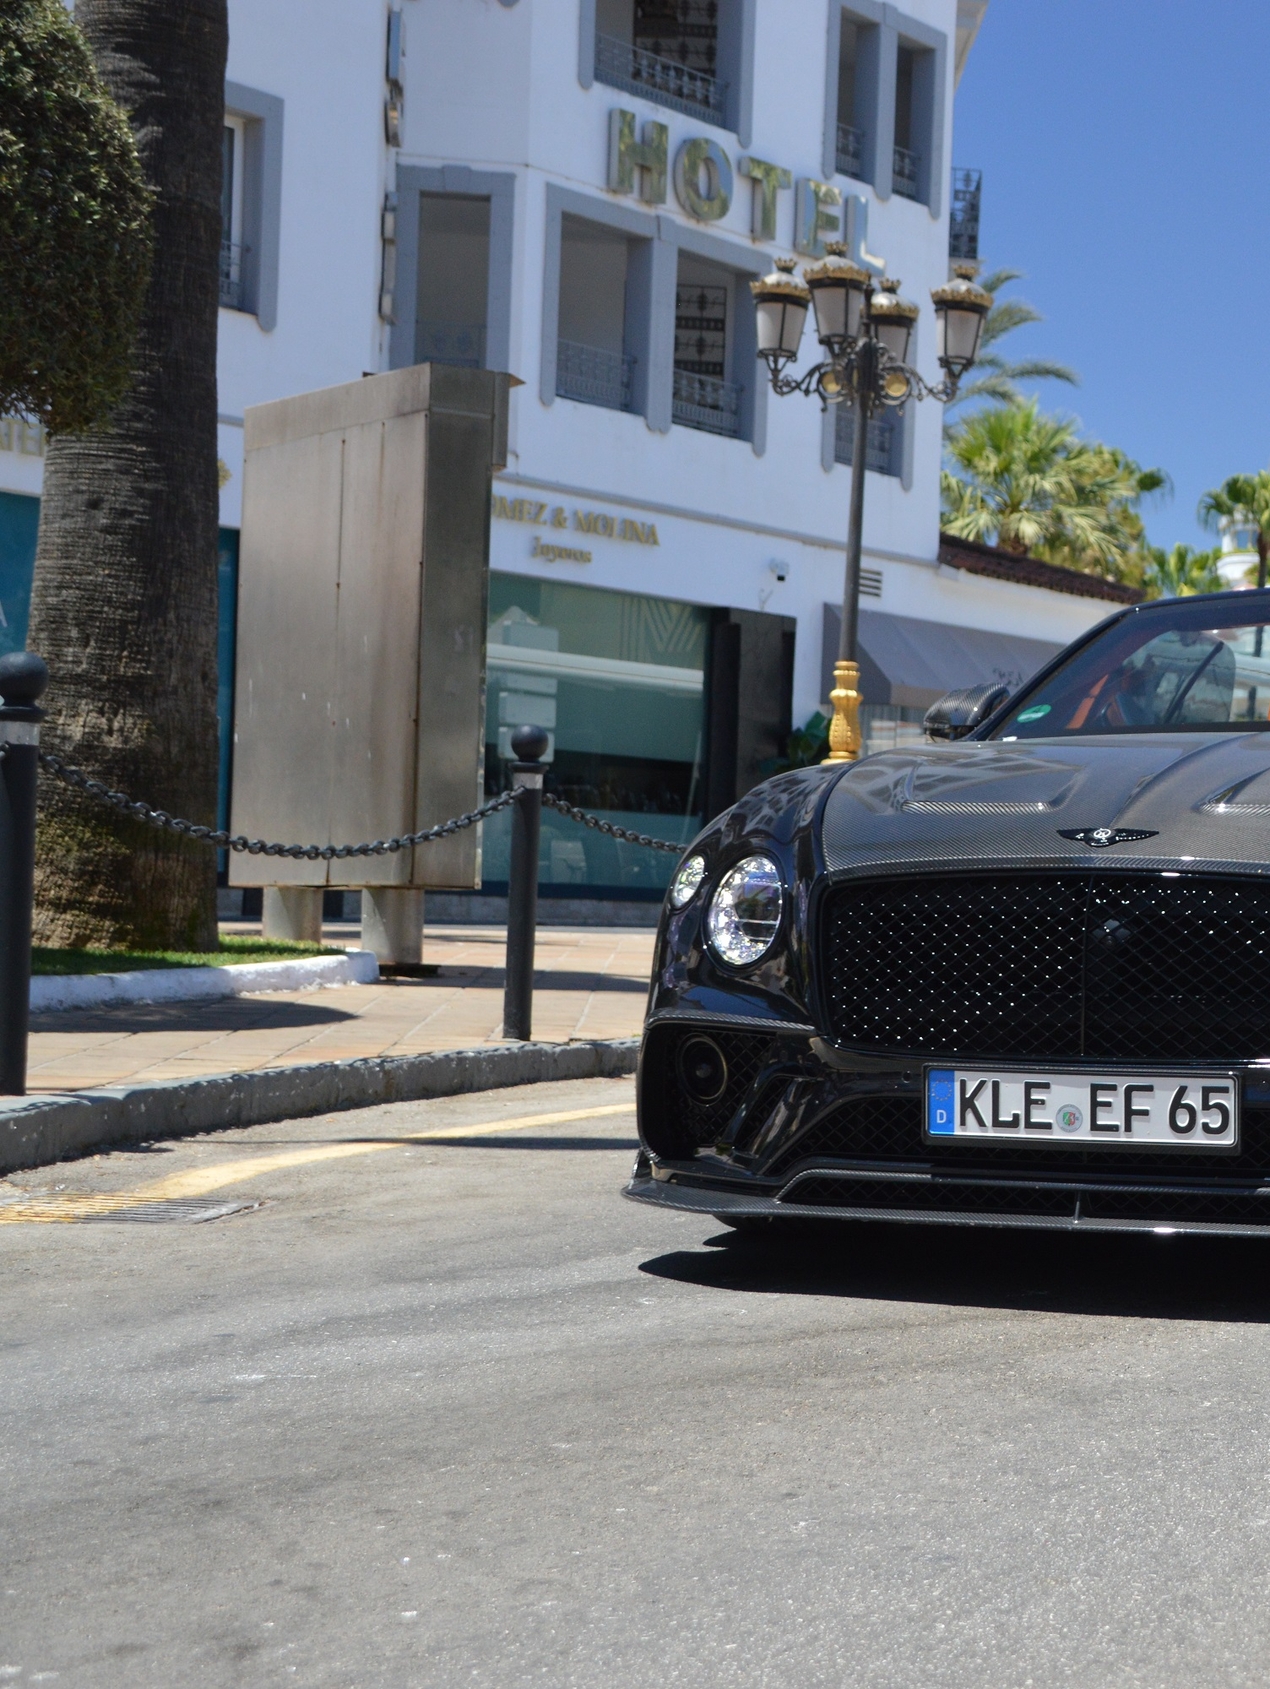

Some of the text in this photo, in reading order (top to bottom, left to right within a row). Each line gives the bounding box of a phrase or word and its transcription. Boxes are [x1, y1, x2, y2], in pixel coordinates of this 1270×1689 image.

[608, 107, 886, 277] HOTEL
[552, 506, 567, 529] &
[573, 508, 661, 547] MOLINA
[936, 1109, 947, 1124] D
[959, 1077, 1053, 1130] KLE
[1089, 1082, 1155, 1133] EF
[1168, 1084, 1230, 1135] 65
